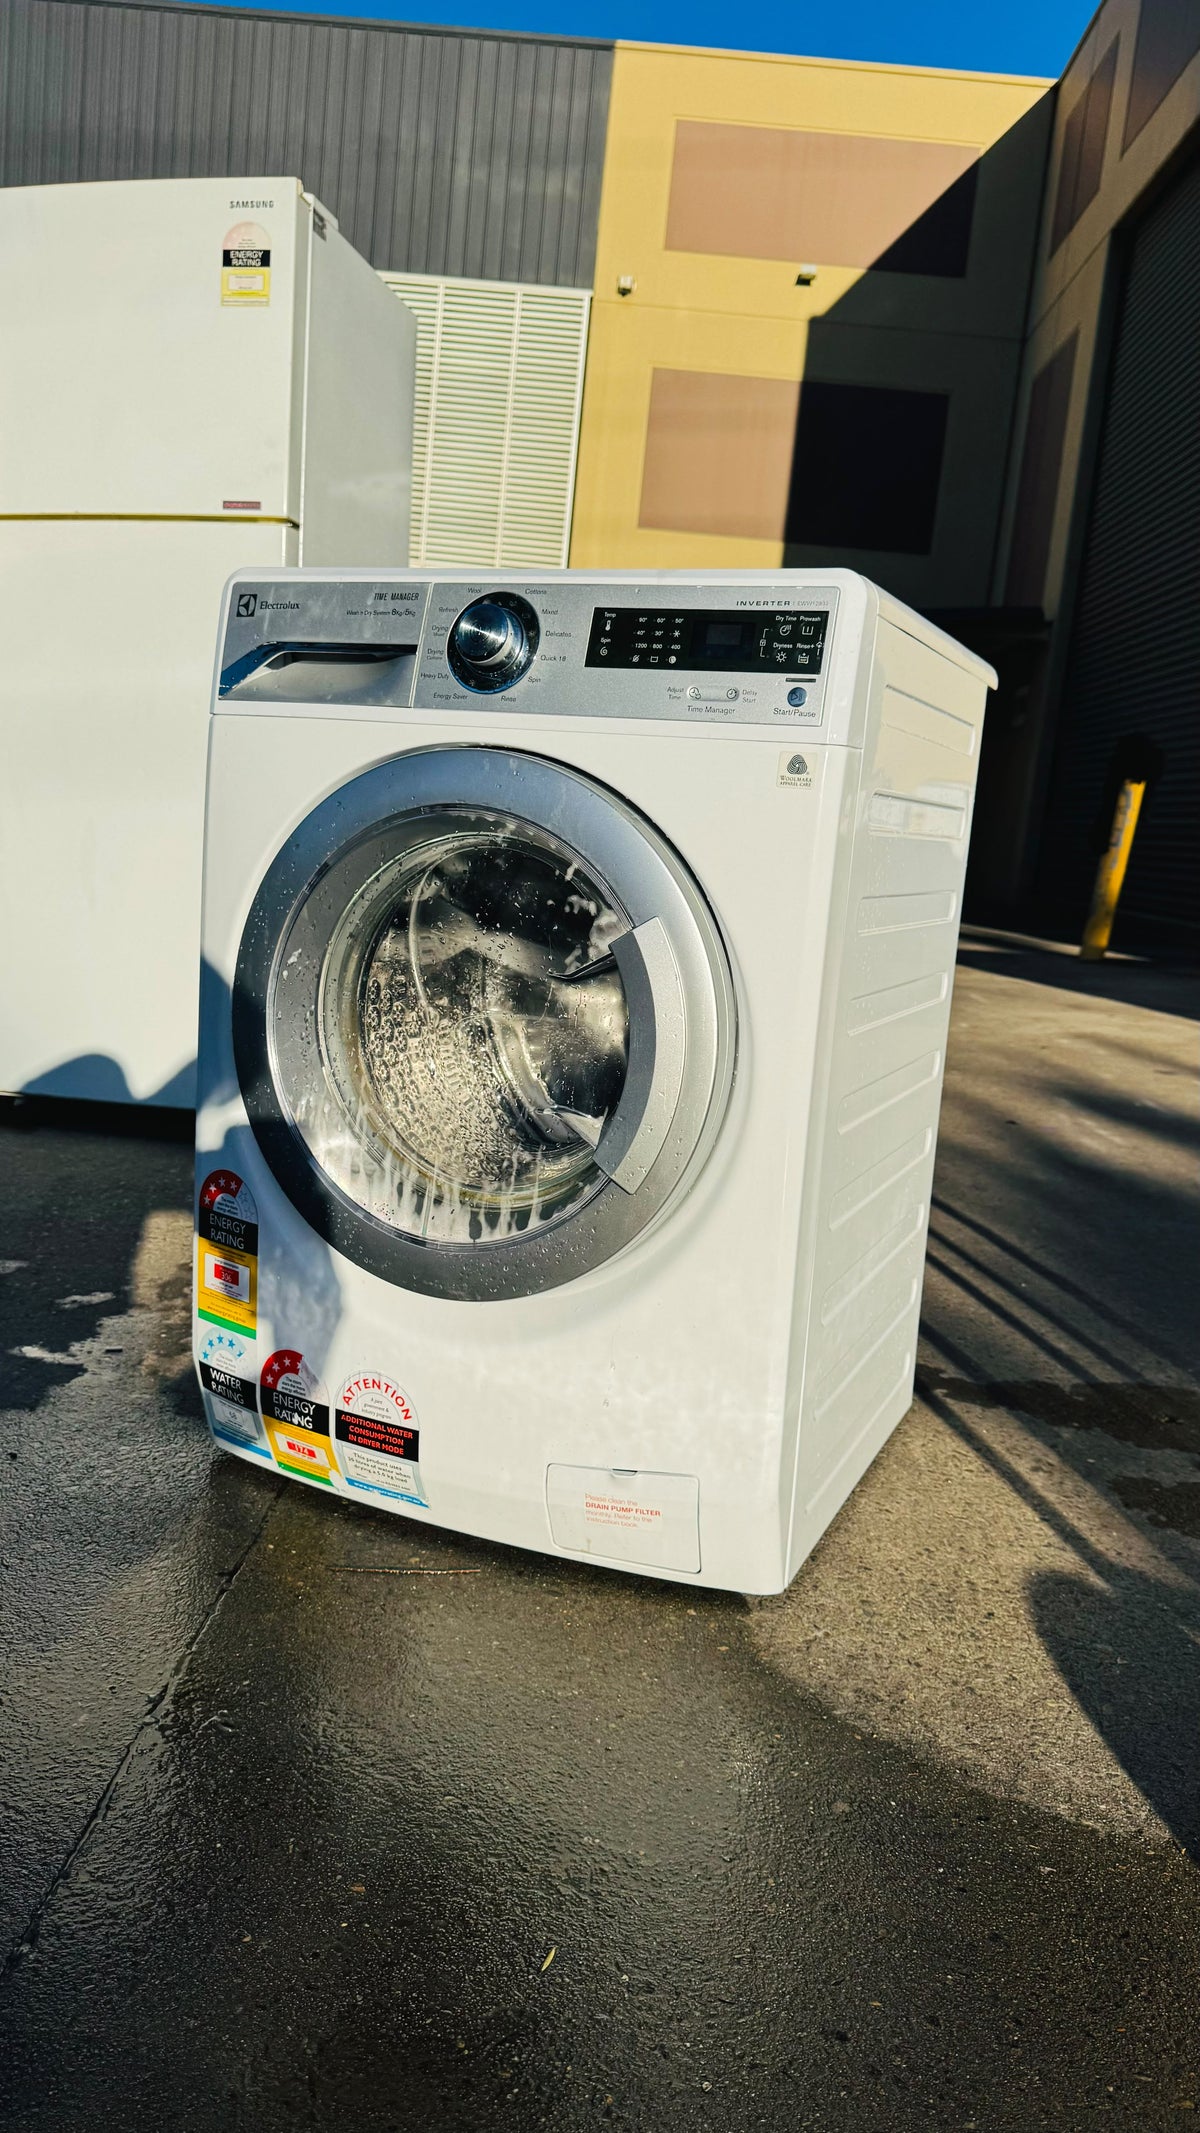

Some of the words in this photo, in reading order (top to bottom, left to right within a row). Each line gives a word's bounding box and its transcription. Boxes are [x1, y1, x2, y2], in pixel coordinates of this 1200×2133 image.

[229, 200, 275, 209] SAMSUNG
[229, 250, 264, 259] ENERGY
[231, 259, 262, 267] RATING
[373, 592, 388, 601] TIME
[390, 592, 420, 601] MANAGER
[259, 600, 300, 610] Electrolux
[540, 654, 557, 662] Quick
[420, 672, 437, 681] Heavy
[437, 672, 450, 681] Duty
[527, 676, 542, 684] Spin
[433, 692, 452, 700] Energy
[687, 705, 703, 713] Time
[704, 706, 736, 716] Manager
[772, 707, 816, 718] Start/Pause
[209, 1213, 246, 1235] ENERGY
[210, 1228, 245, 1250] RATING
[209, 1367, 241, 1391] WATER
[211, 1381, 244, 1405] RATING
[272, 1391, 316, 1416] ENERGY
[342, 1378, 412, 1420] ATTENTION
[340, 1414, 387, 1432] ADDITIONAL
[386, 1426, 413, 1439] WATER
[348, 1425, 404, 1446] CONSUMPTION
[348, 1434, 357, 1442] IN
[357, 1436, 380, 1449] DRYER
[381, 1443, 405, 1455] MODE
[353, 1452, 365, 1460] This
[585, 1493, 607, 1502] Please
[585, 1501, 609, 1510] DRAIN
[610, 1505, 634, 1513] PUMP
[635, 1508, 661, 1516] FILTER
